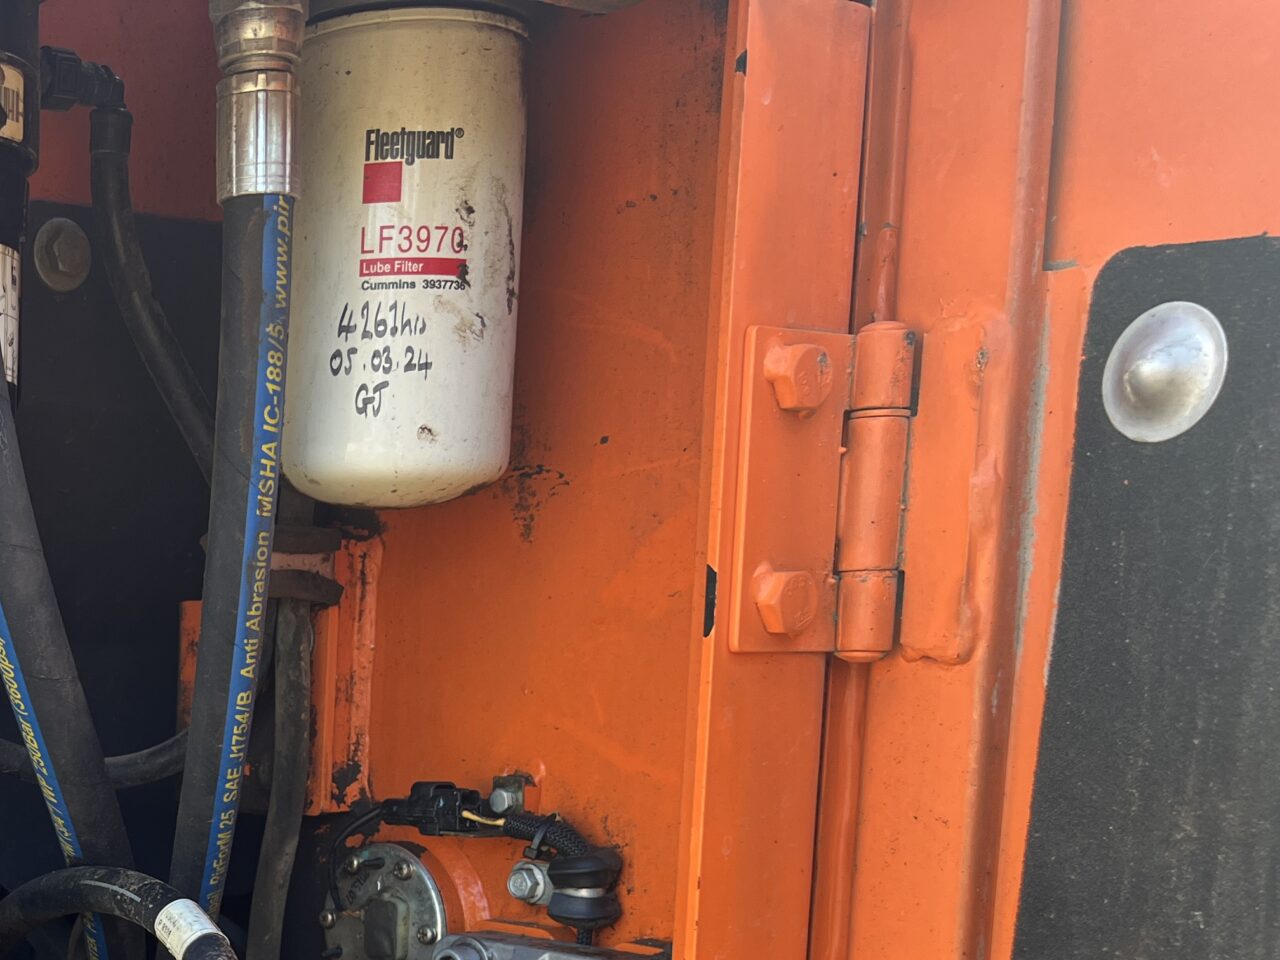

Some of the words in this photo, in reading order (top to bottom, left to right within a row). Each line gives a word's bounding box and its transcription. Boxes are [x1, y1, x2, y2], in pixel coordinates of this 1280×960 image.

[361, 225, 465, 254] LF3970
[361, 279, 416, 291] Cummins
[363, 261, 391, 274] Lube
[394, 260, 424, 273] Filter
[256, 441, 278, 517] MSHA
[245, 531, 270, 632] Abrasion
[240, 639, 260, 679] Anti
[230, 690, 254, 762] J1754/B
[223, 764, 242, 803] SAE
[220, 808, 236, 828] 25
